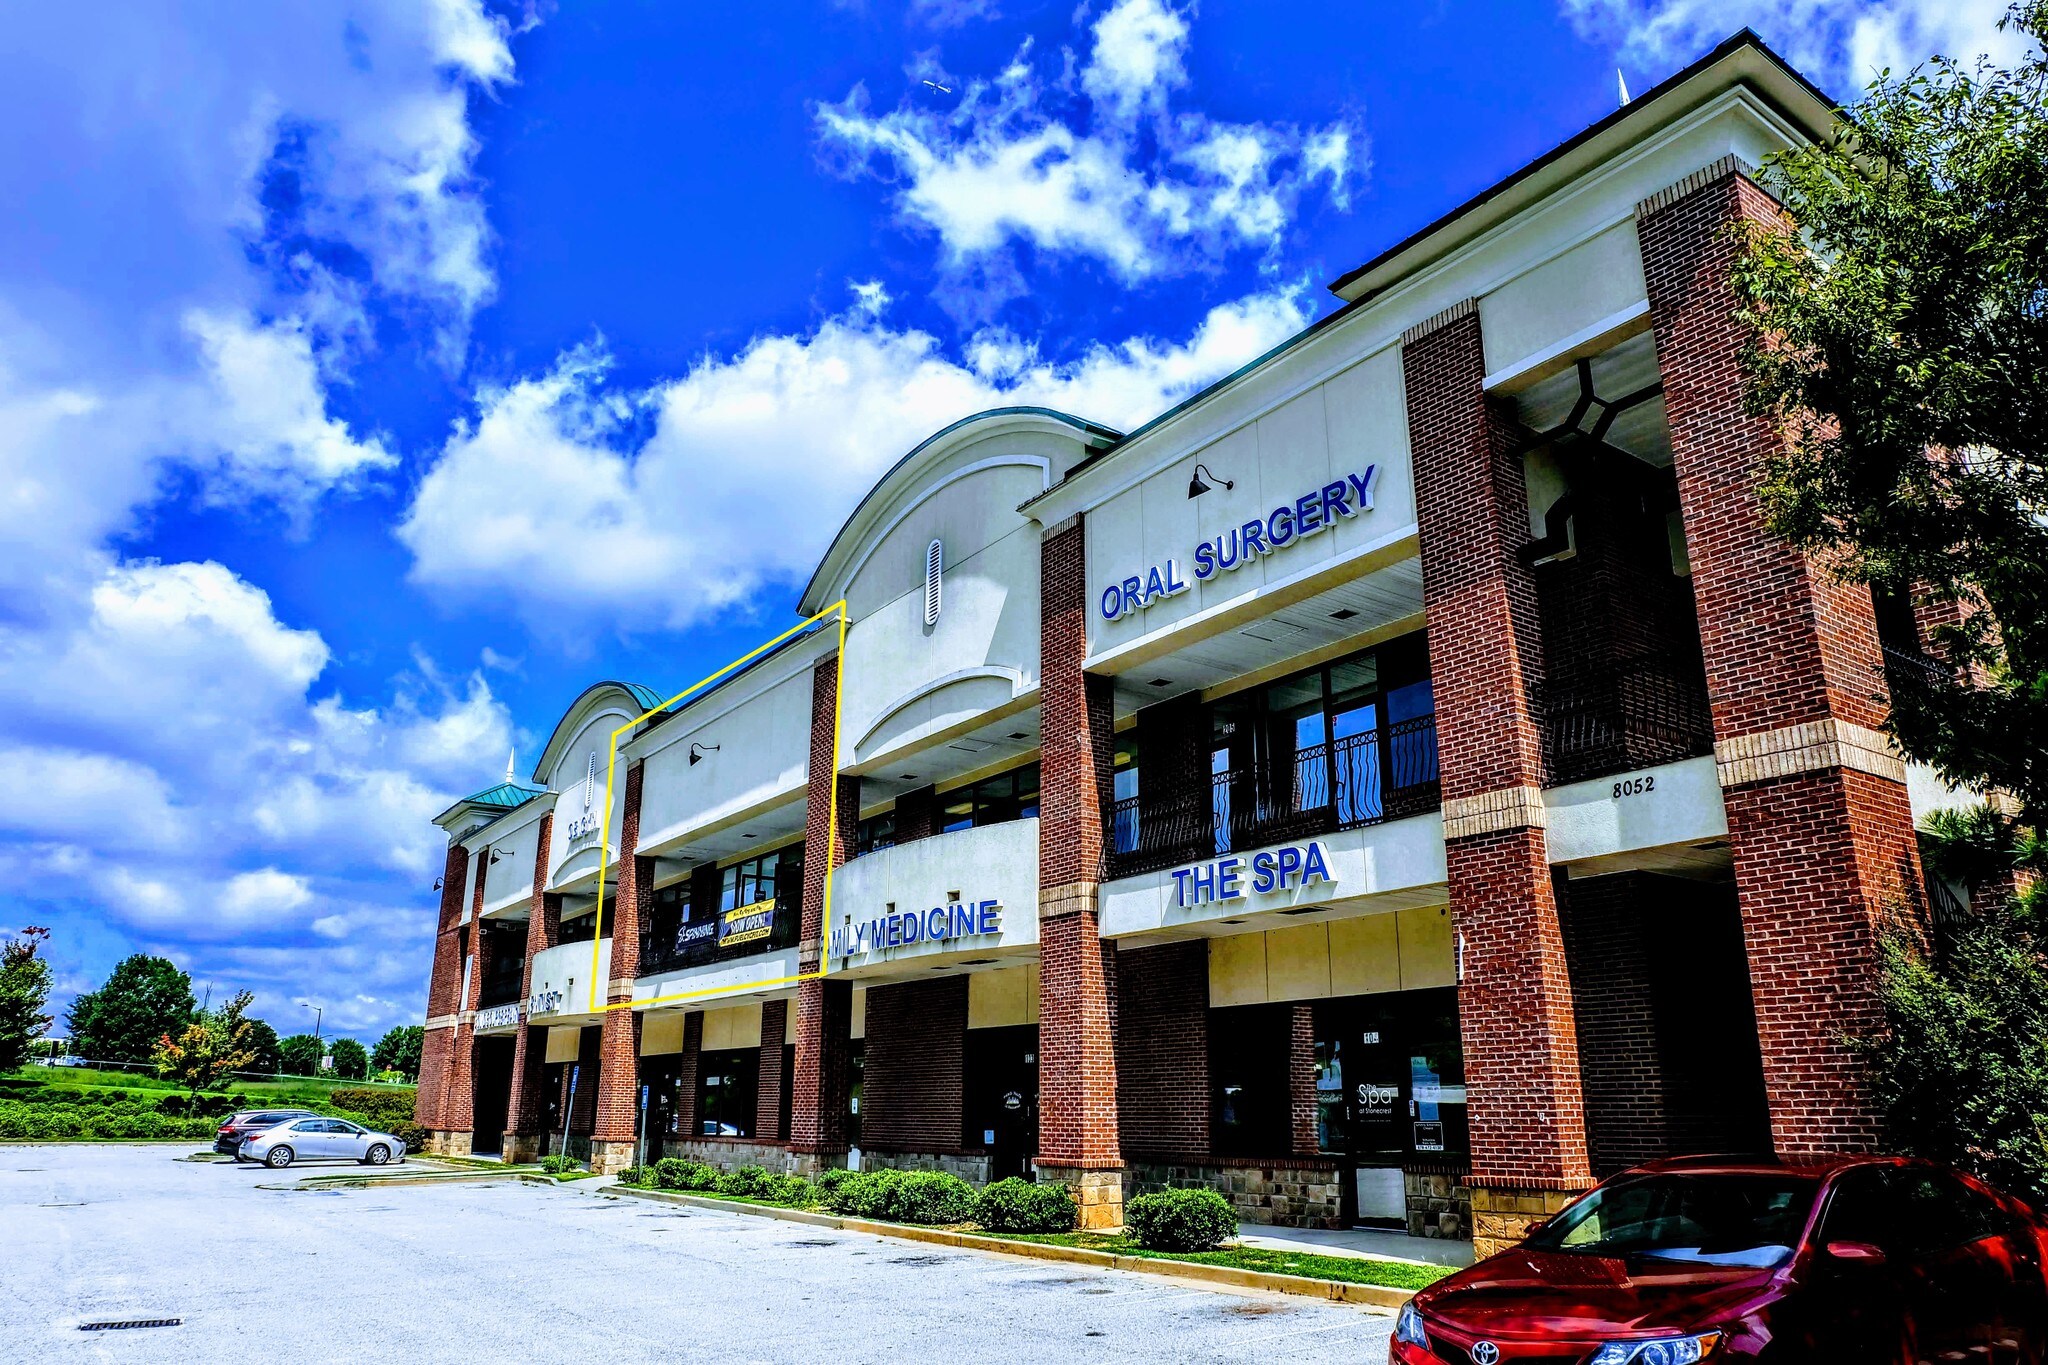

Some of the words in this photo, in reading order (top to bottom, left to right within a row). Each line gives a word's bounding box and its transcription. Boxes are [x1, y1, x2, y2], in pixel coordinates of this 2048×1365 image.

[1101, 559, 1188, 621] ORAL
[1194, 464, 1379, 580] SURGERY
[1613, 776, 1655, 798] 8052
[1171, 858, 1244, 908] THE
[1252, 841, 1335, 894] SPA
[871, 899, 1001, 950] MEDICINE
[1358, 1083, 1392, 1108] Spa
